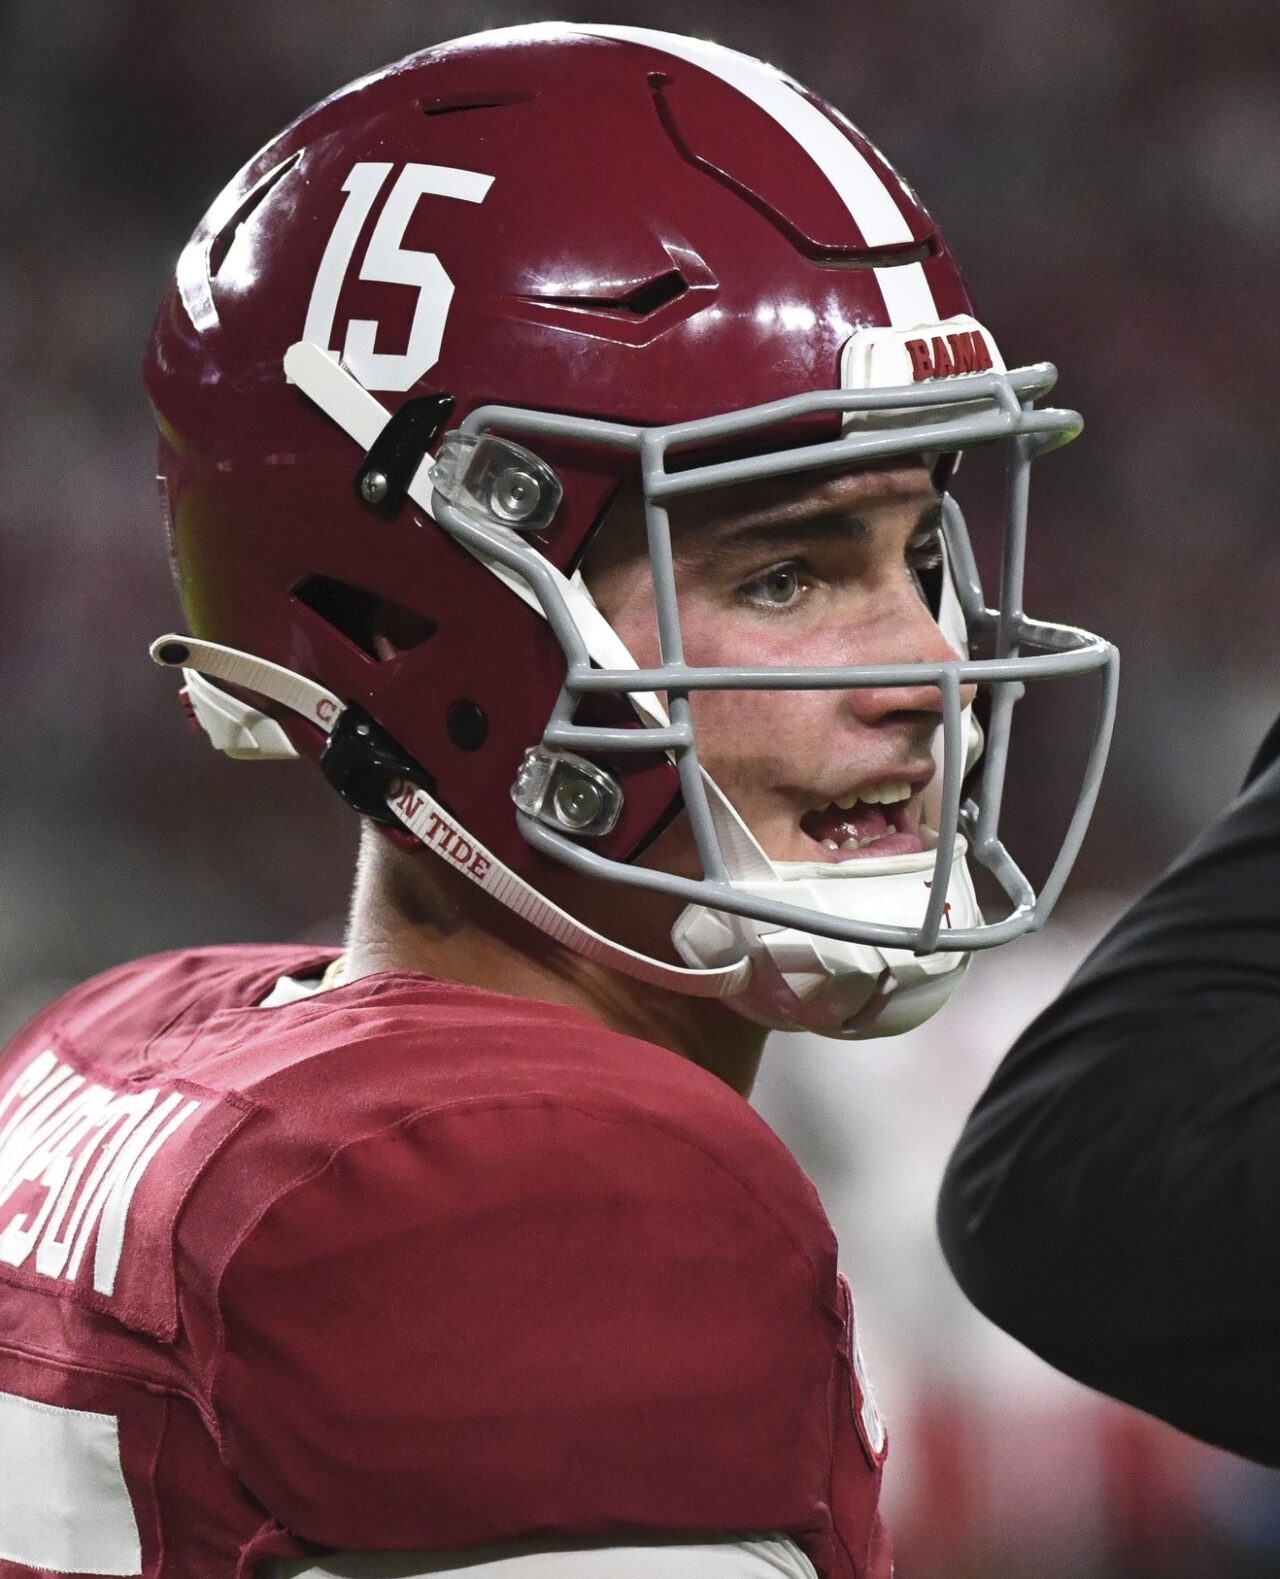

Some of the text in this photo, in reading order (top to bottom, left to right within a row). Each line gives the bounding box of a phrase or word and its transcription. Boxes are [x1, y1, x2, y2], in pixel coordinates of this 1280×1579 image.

[286, 162, 496, 392] 15
[905, 330, 993, 382] BAMA
[425, 811, 492, 881] TIDE
